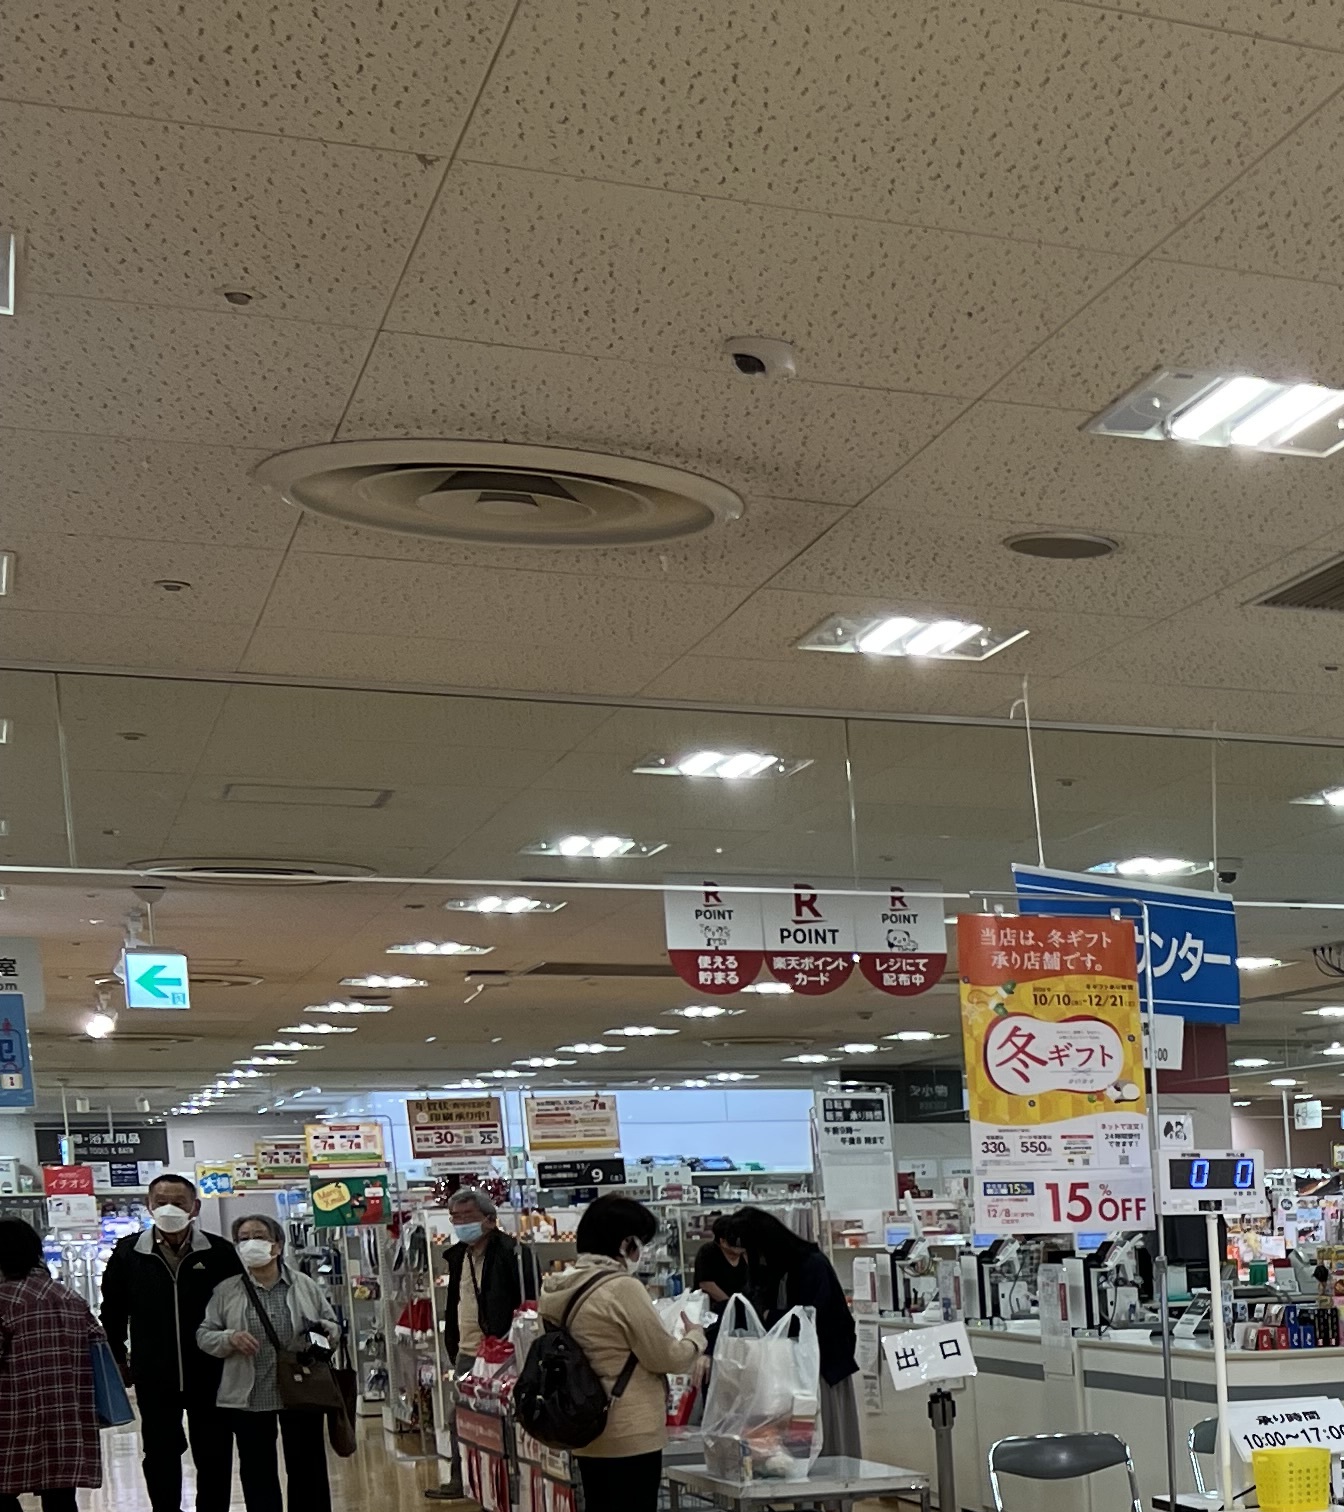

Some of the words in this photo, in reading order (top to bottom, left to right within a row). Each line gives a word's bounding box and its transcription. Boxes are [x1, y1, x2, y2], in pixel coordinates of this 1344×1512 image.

[695, 909, 734, 921] POINT
[881, 913, 919, 925] POINT
[780, 928, 840, 945] POINT
[980, 927, 1113, 949] 当店は、冬ギフト
[773, 956, 849, 971] 楽天ポイント
[876, 957, 929, 972] レジにて
[990, 950, 1104, 972] 承り店舗です。
[795, 973, 830, 986] カード
[995, 1024, 1114, 1084] 冬ギフト
[1256, 1410, 1321, 1426] 承り時間
